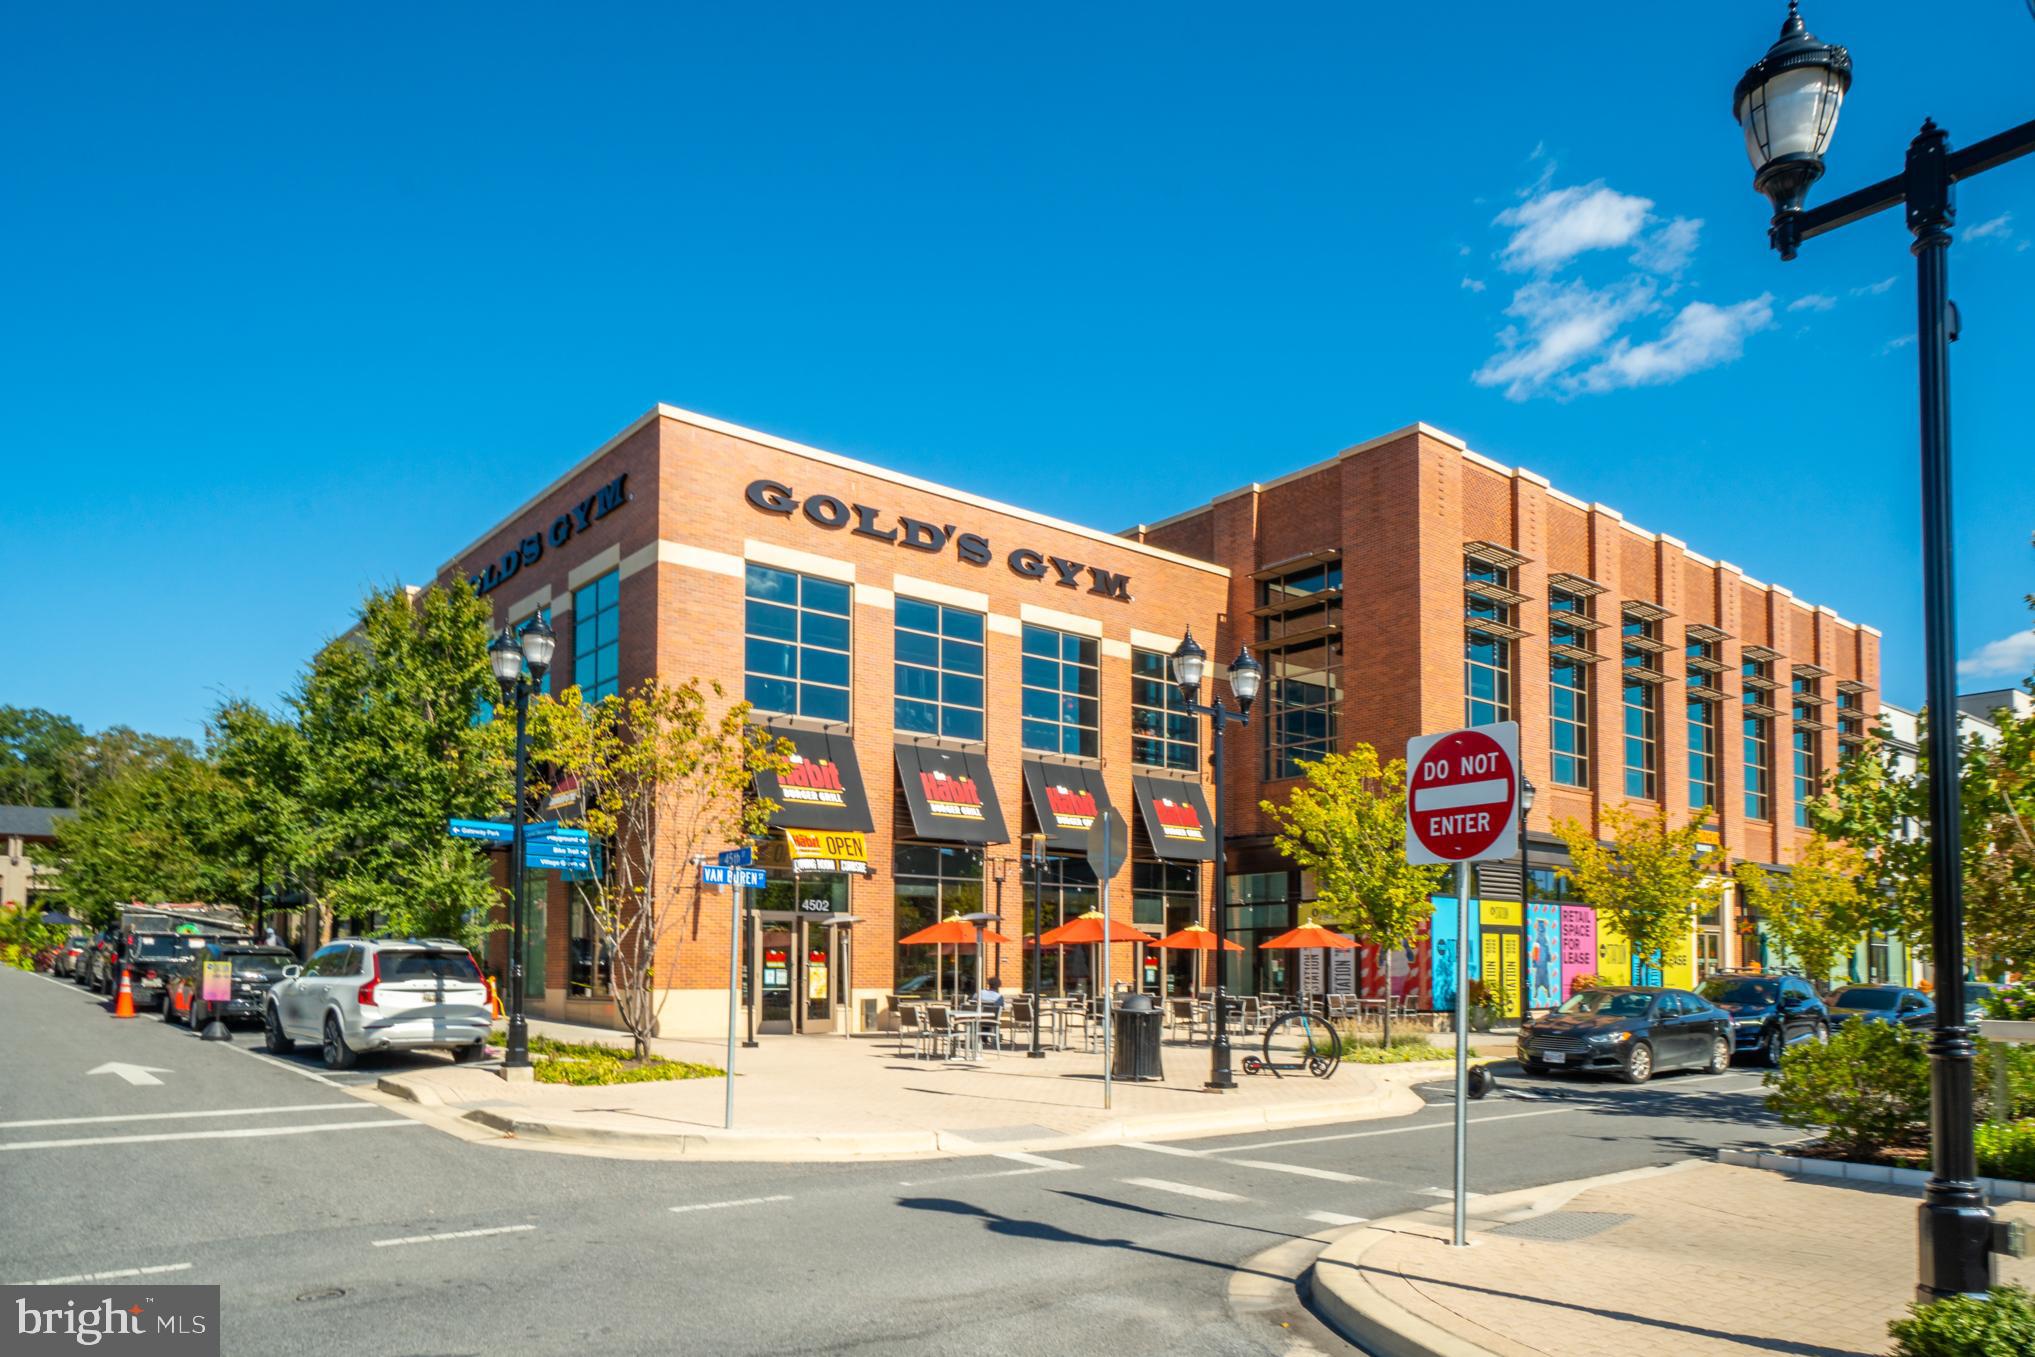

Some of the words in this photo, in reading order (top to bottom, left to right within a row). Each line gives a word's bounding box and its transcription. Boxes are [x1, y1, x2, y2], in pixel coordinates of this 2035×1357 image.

[548, 473, 628, 548] GYM
[745, 479, 992, 567] GOLD'S
[1007, 549, 1132, 603] GYM
[1424, 760, 1449, 781] DO
[1461, 752, 1499, 776] NOT
[920, 772, 981, 804] Habit
[1046, 787, 1098, 817] Habit
[1153, 800, 1201, 828] Habit
[1430, 812, 1491, 837] ENTER
[793, 833, 821, 849] Habit
[826, 836, 864, 857] OPEN
[704, 868, 724, 882] VAN
[727, 869, 758, 885] BUREN
[801, 899, 830, 912] 4502
[1563, 910, 1591, 924] RETAIL
[1563, 924, 1590, 937] SPACE
[1563, 938, 1581, 950] FOR
[1563, 952, 1590, 965] LEASE
[1335, 959, 1352, 994] TATION
